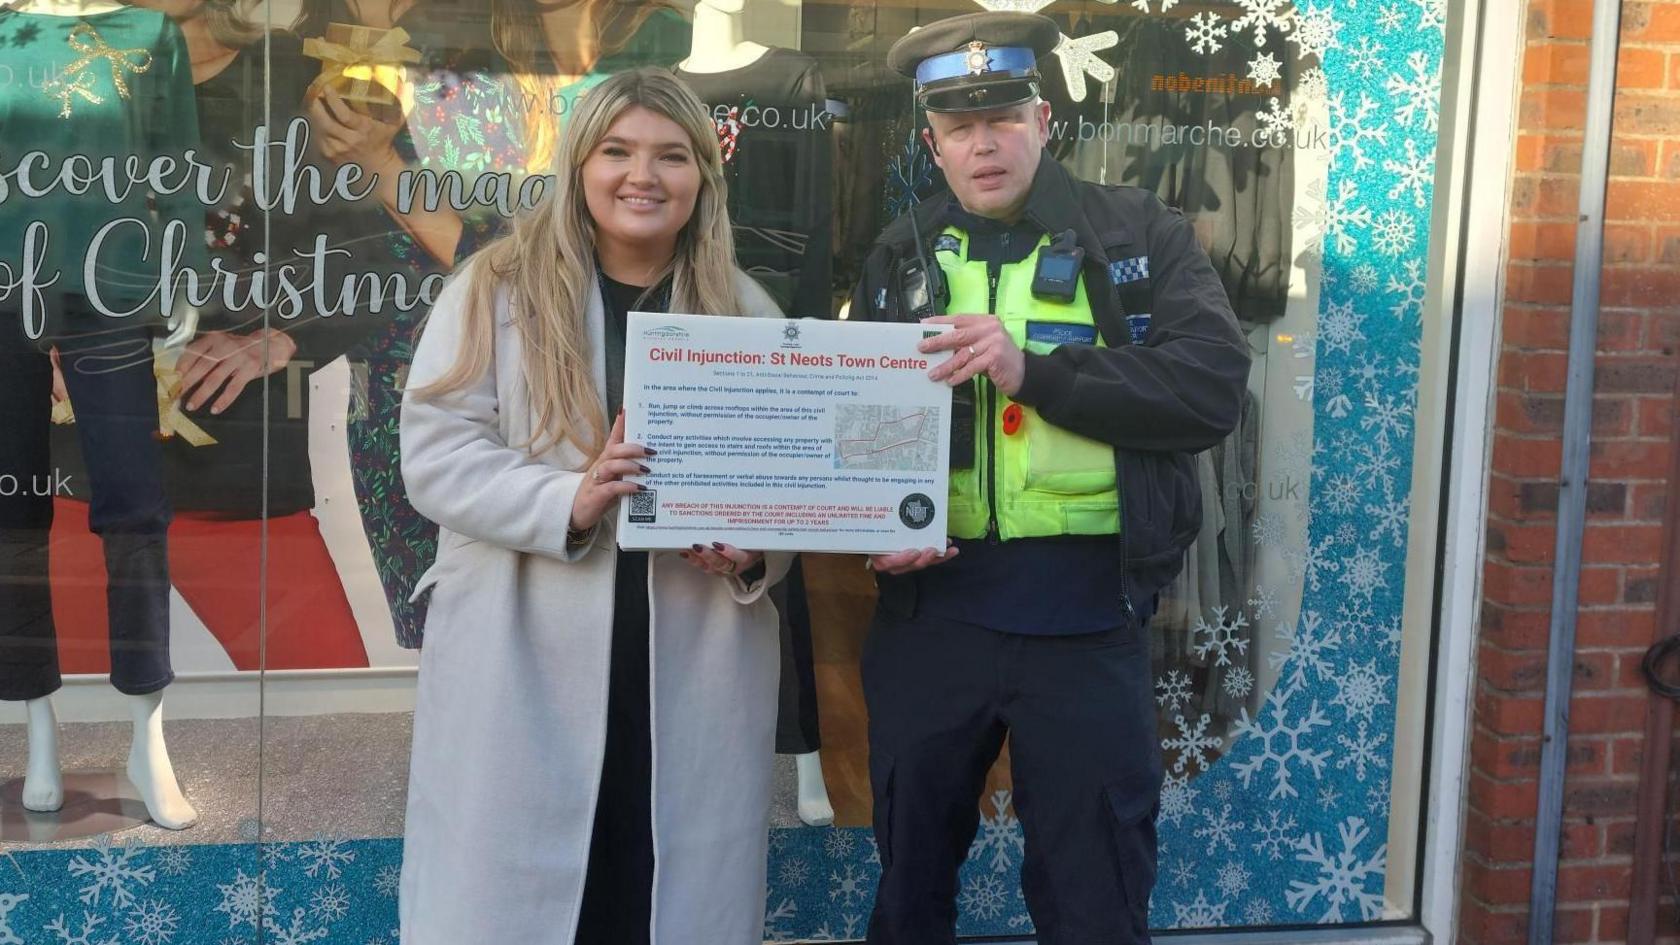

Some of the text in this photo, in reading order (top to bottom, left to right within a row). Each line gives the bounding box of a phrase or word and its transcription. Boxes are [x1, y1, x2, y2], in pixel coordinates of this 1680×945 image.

[231, 116, 380, 215] the
[649, 348, 928, 369] Civil Injunction: St Neots Town Centre
